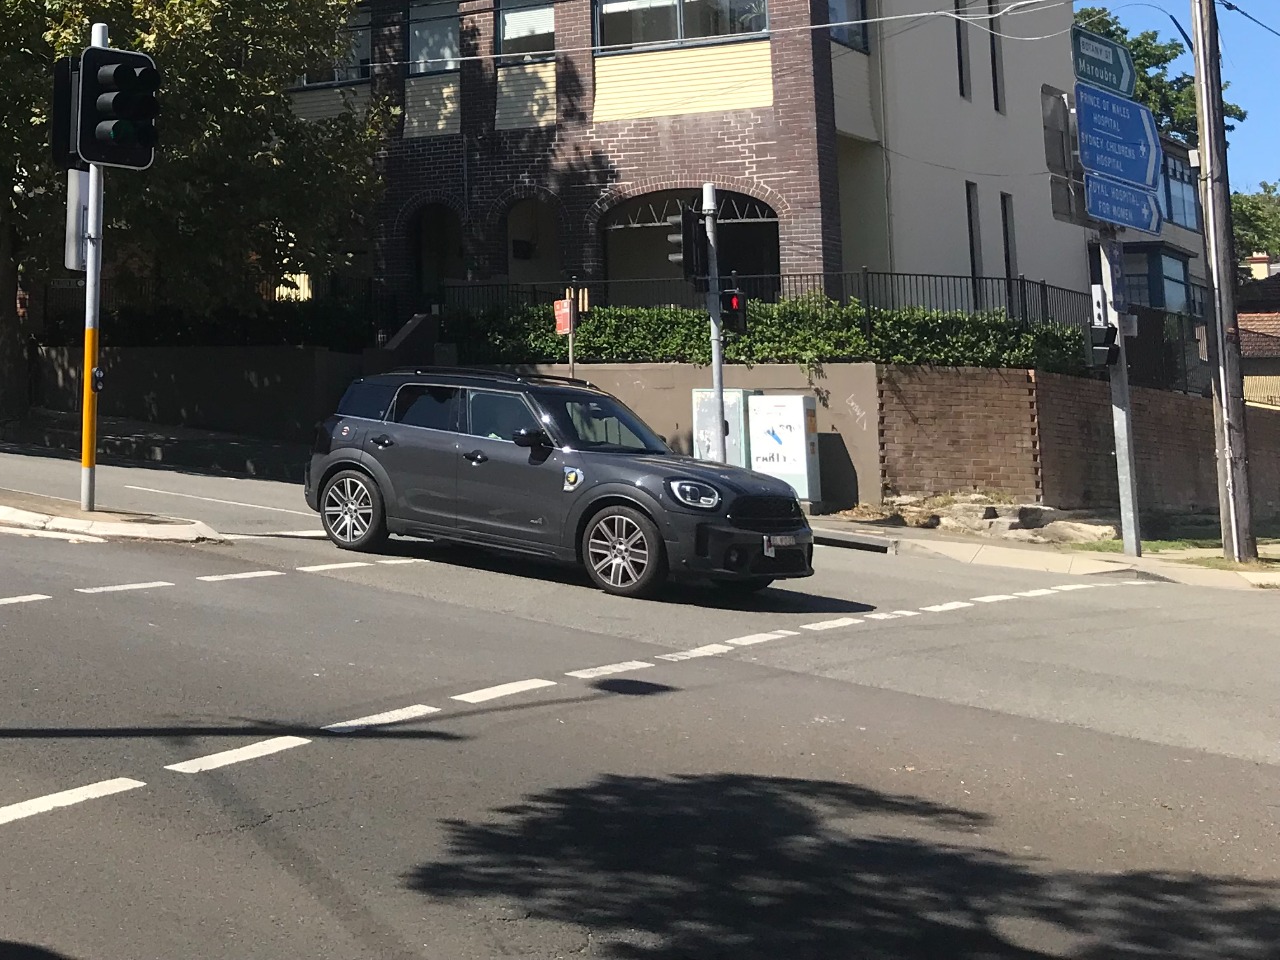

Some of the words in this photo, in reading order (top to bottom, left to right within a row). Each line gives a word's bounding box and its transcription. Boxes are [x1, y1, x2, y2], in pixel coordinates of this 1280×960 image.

[1081, 40, 1103, 57] BOTANY
[1104, 49, 1111, 60] ST
[1078, 57, 1117, 85] Maroubra
[1079, 91, 1100, 109] PRINCE
[1102, 99, 1109, 111] OF
[1111, 103, 1130, 119] WALES
[1093, 113, 1121, 132] HOSPITAL
[1081, 132, 1104, 149] SYDNEY
[1096, 155, 1123, 172] HOSPITAL
[1088, 180, 1109, 196] ROYAL
[1110, 187, 1140, 206] HOSPITAL
[1098, 200, 1111, 215] FOR
[1112, 205, 1134, 222] WOMEN
